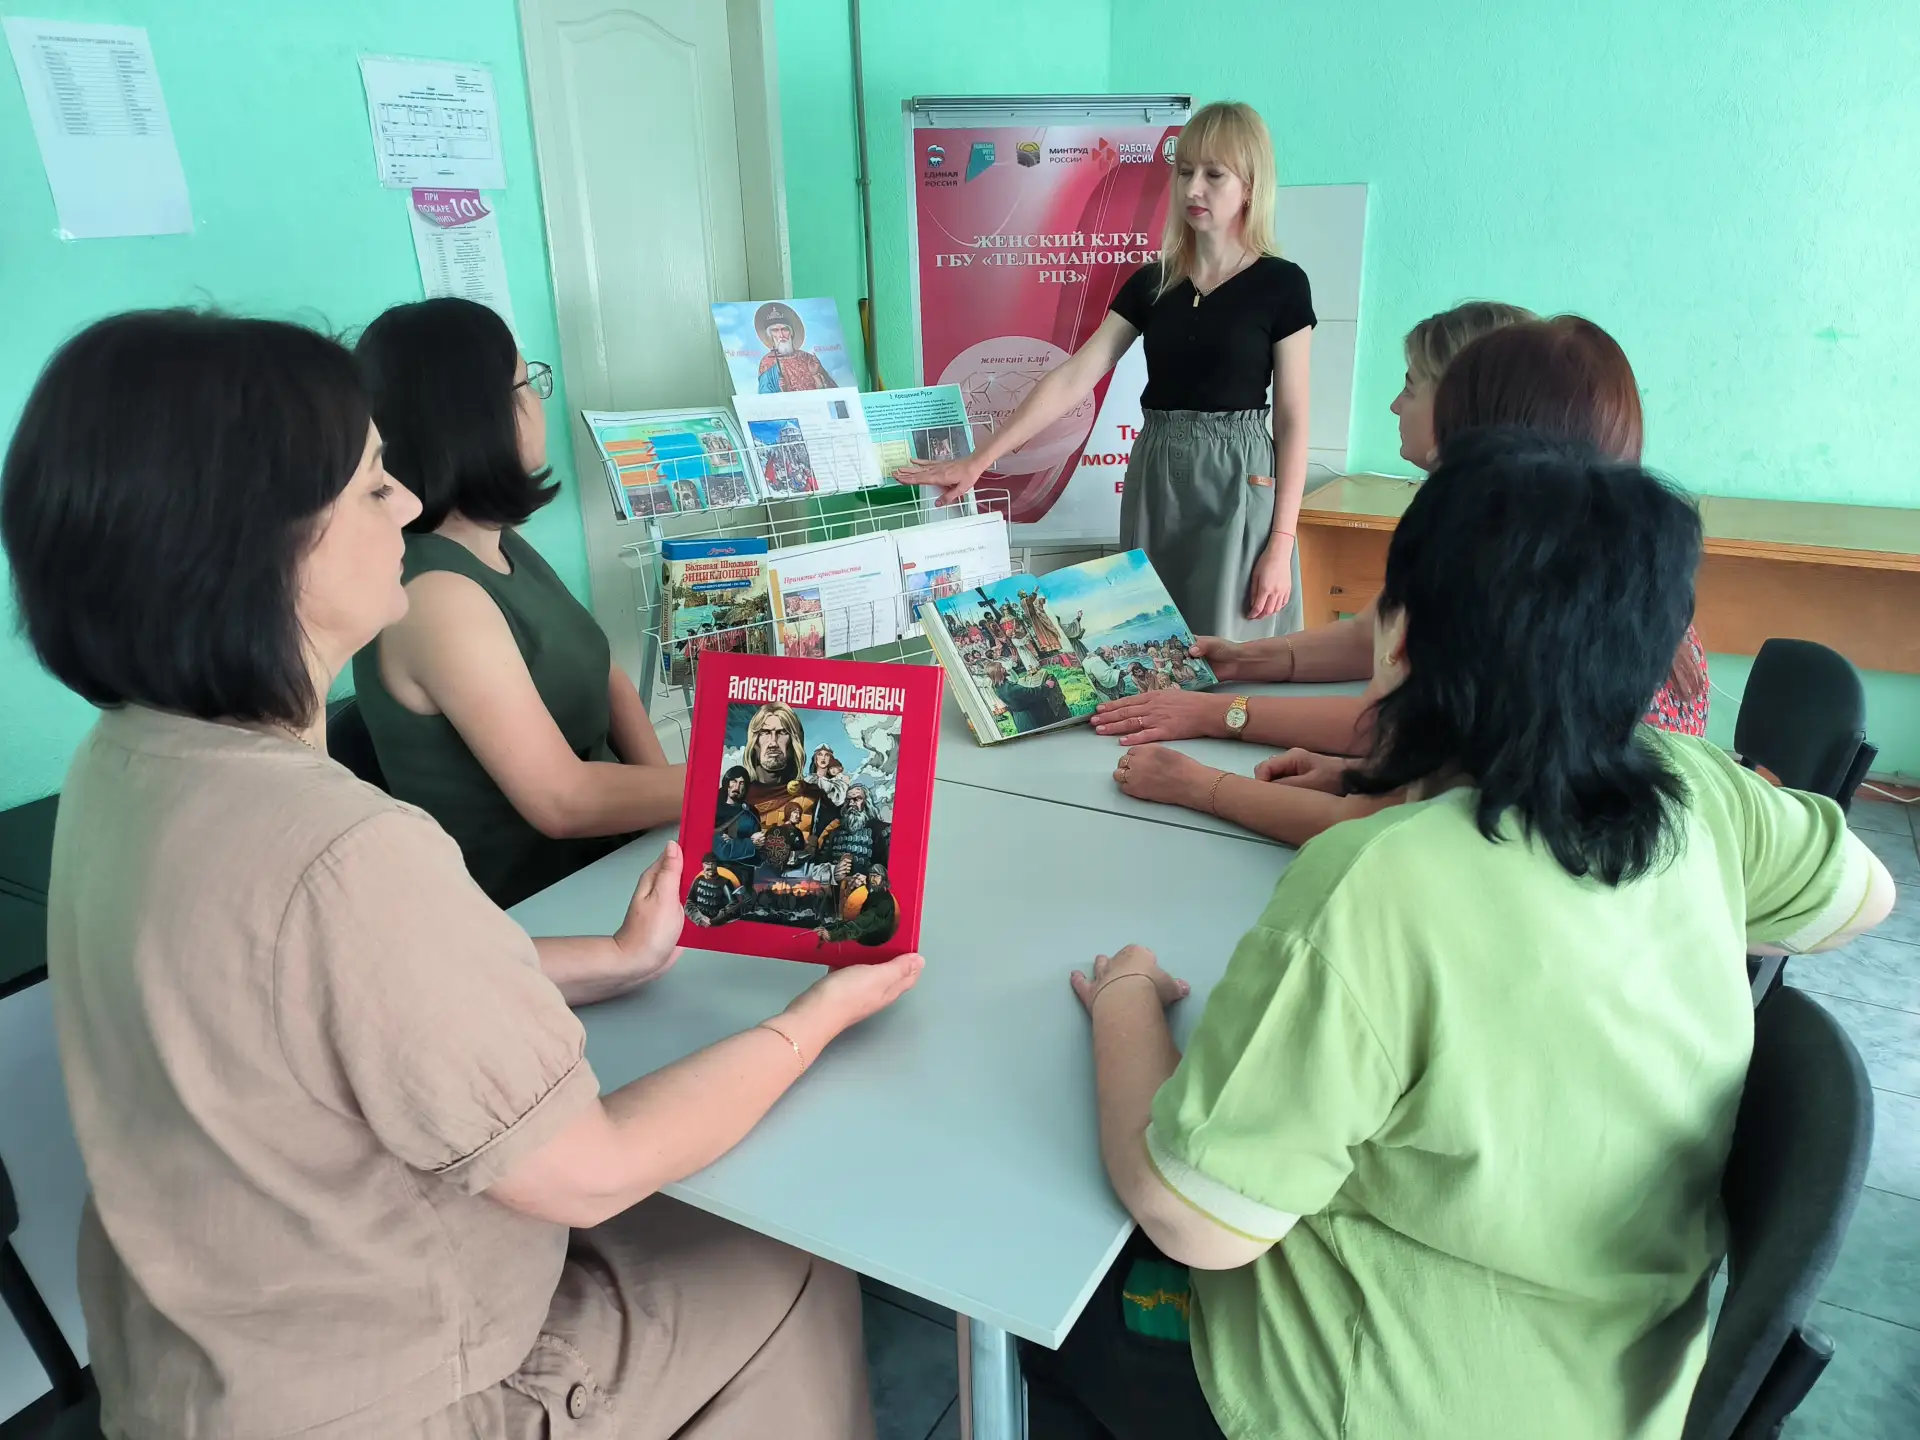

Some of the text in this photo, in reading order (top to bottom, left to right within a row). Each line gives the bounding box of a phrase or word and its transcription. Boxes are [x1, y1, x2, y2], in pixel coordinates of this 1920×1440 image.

[1119, 144, 1151, 153] РАБОТА
[1120, 154, 1154, 164] РОССИИ
[424, 192, 439, 201] ПРИ
[417, 204, 450, 213] ПОЖАРЕ
[449, 197, 491, 218] 101
[973, 230, 1149, 249] ЖЕНСКИЙ КЛУБ
[935, 250, 1162, 267] ГБУ «ТЕЛЬМАНОВСК
[1038, 269, 1087, 285] РЦЗ»
[980, 350, 1051, 366] женский клуб
[685, 560, 758, 572] Большая Школьная
[682, 567, 761, 583] ЭНЦИКЛОПЕДИЯ
[728, 675, 906, 712] АЛЕКСАНДР ЯРОСЛАВИЧ
